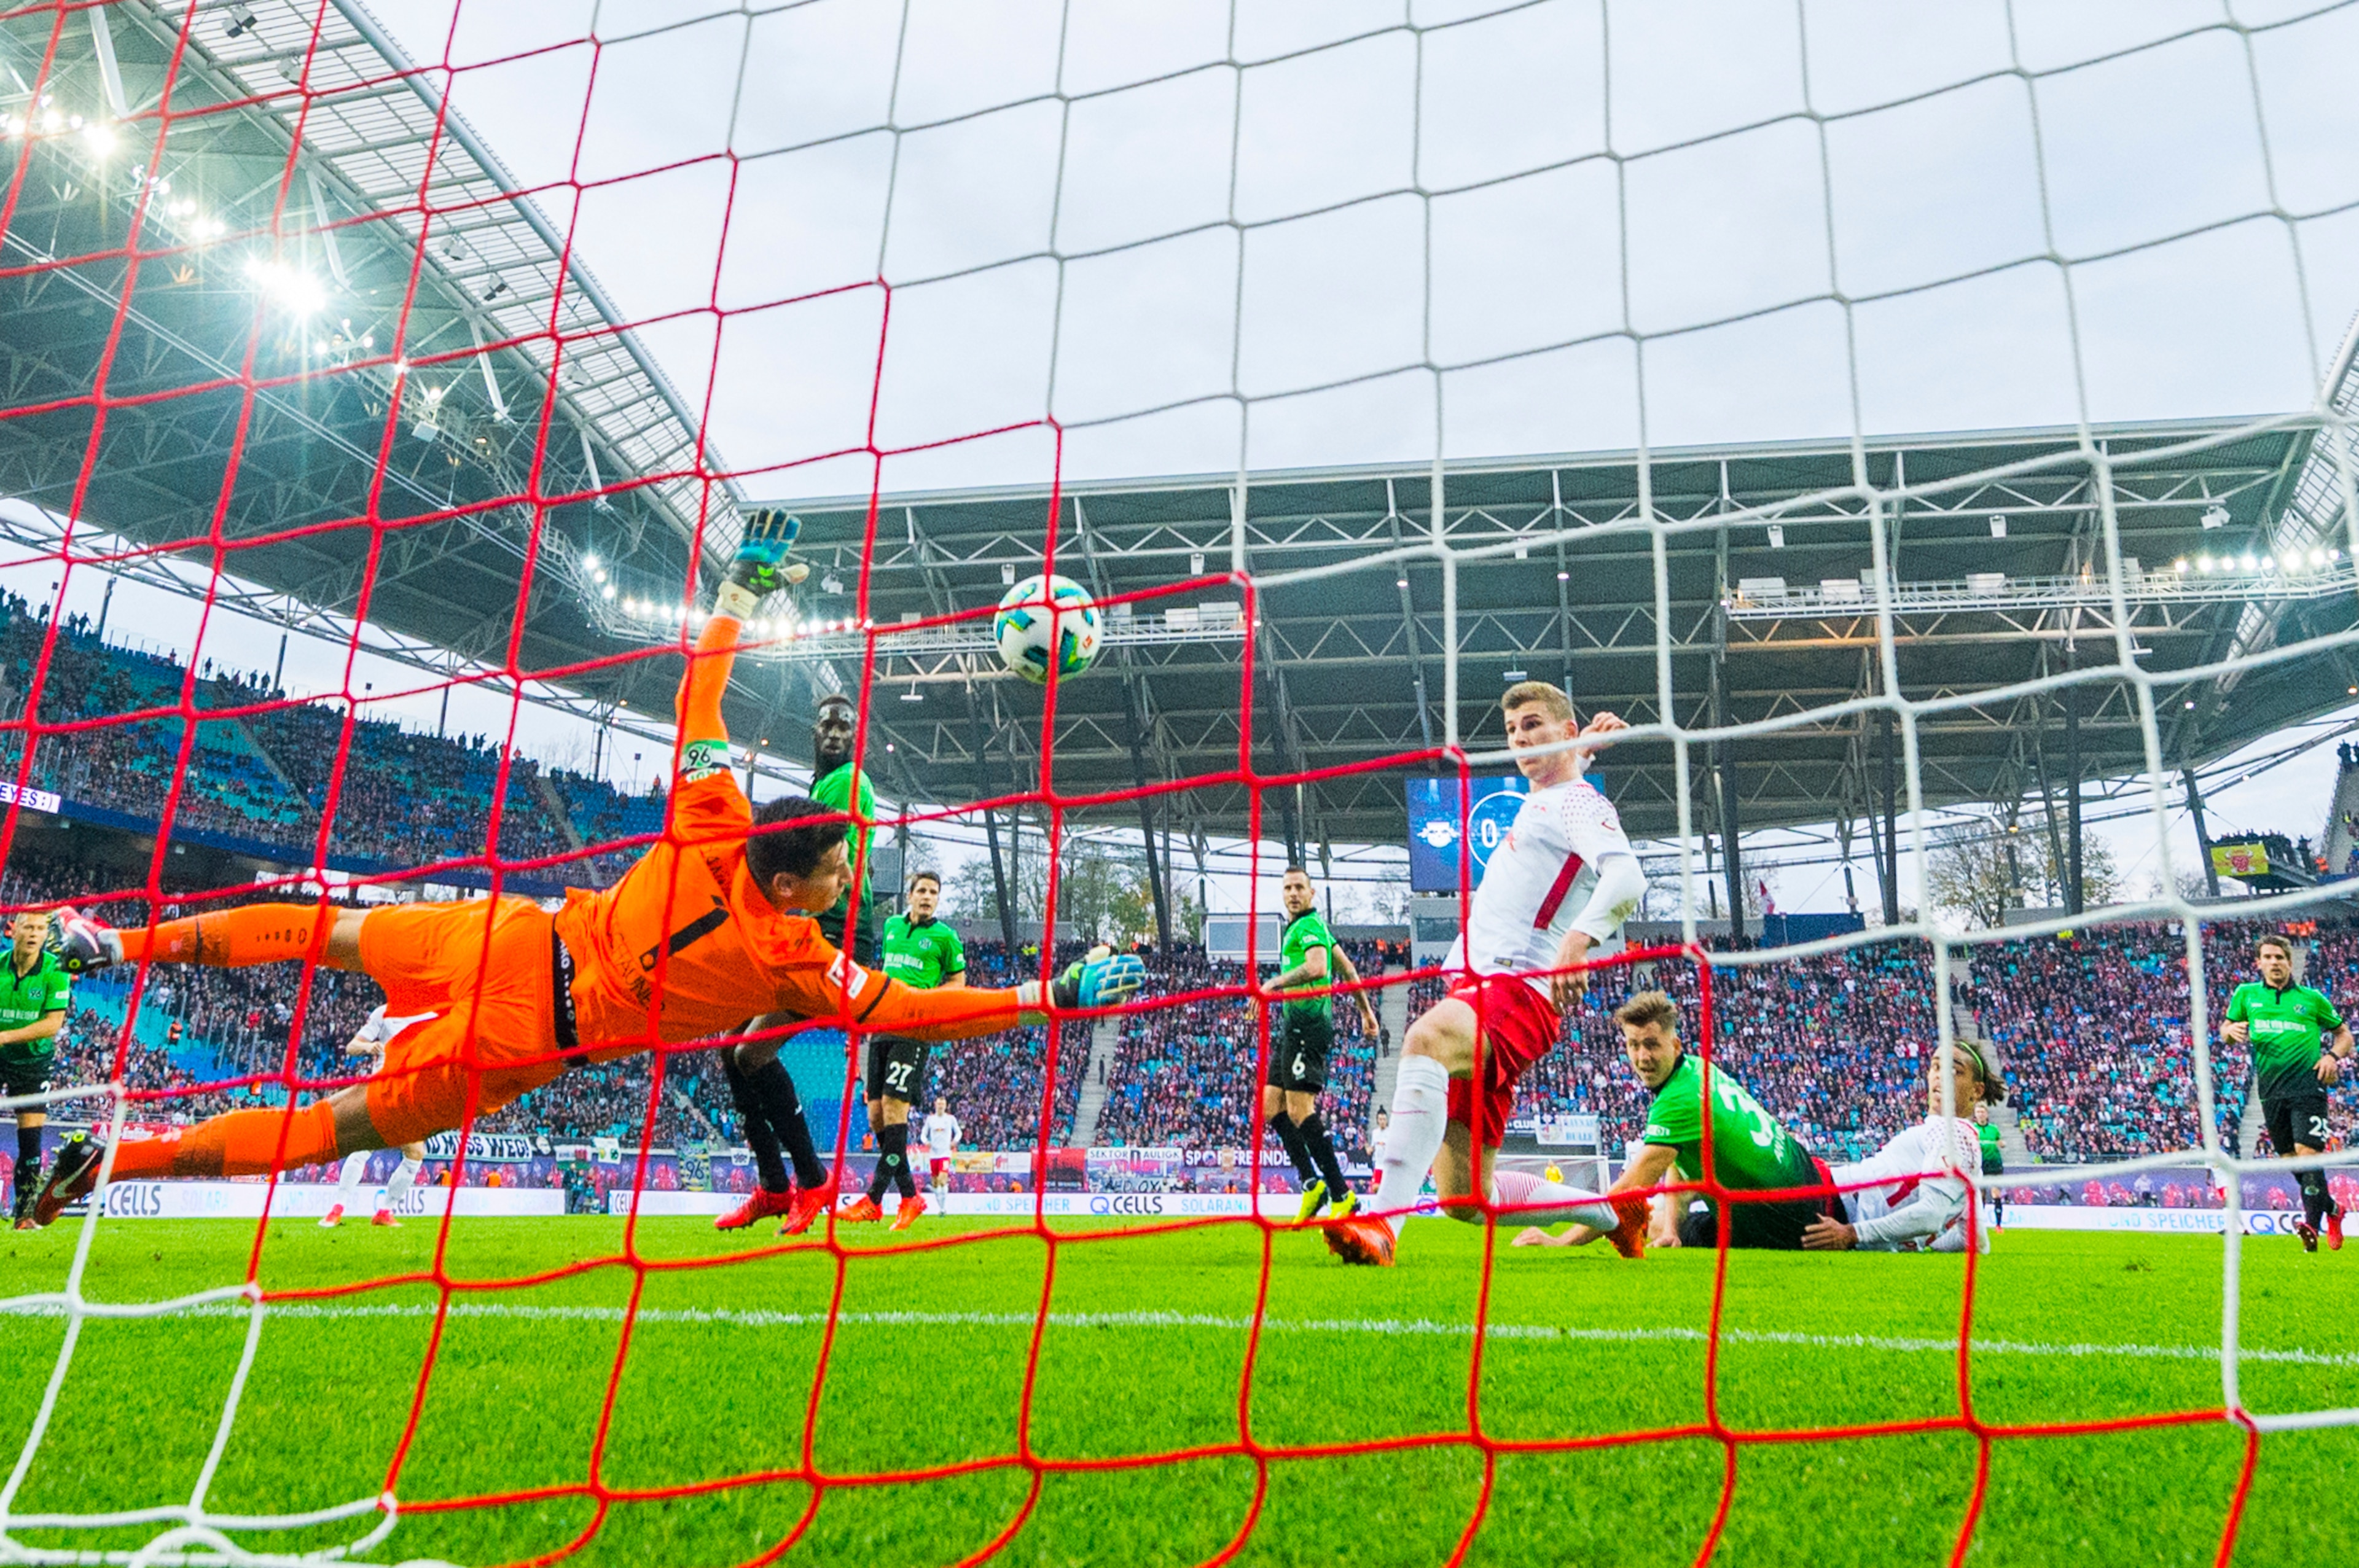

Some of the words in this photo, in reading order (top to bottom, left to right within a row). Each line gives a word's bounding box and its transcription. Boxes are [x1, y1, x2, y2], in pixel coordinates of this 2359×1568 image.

[689, 747, 711, 766] 96
[1481, 819, 1497, 848] 0
[885, 1061, 913, 1086] 27
[1292, 1053, 1305, 1082] 6
[2309, 1115, 2333, 1139] 25
[444, 1134, 484, 1156] MSS
[487, 1137, 530, 1158] WEG!
[686, 1160, 705, 1180] 96
[109, 1185, 161, 1215] CELLS
[1006, 1198, 1070, 1212] SPEIHER
[1090, 1196, 1109, 1214] Q
[1113, 1196, 1163, 1214] CELLS
[2250, 1214, 2275, 1234] Q
